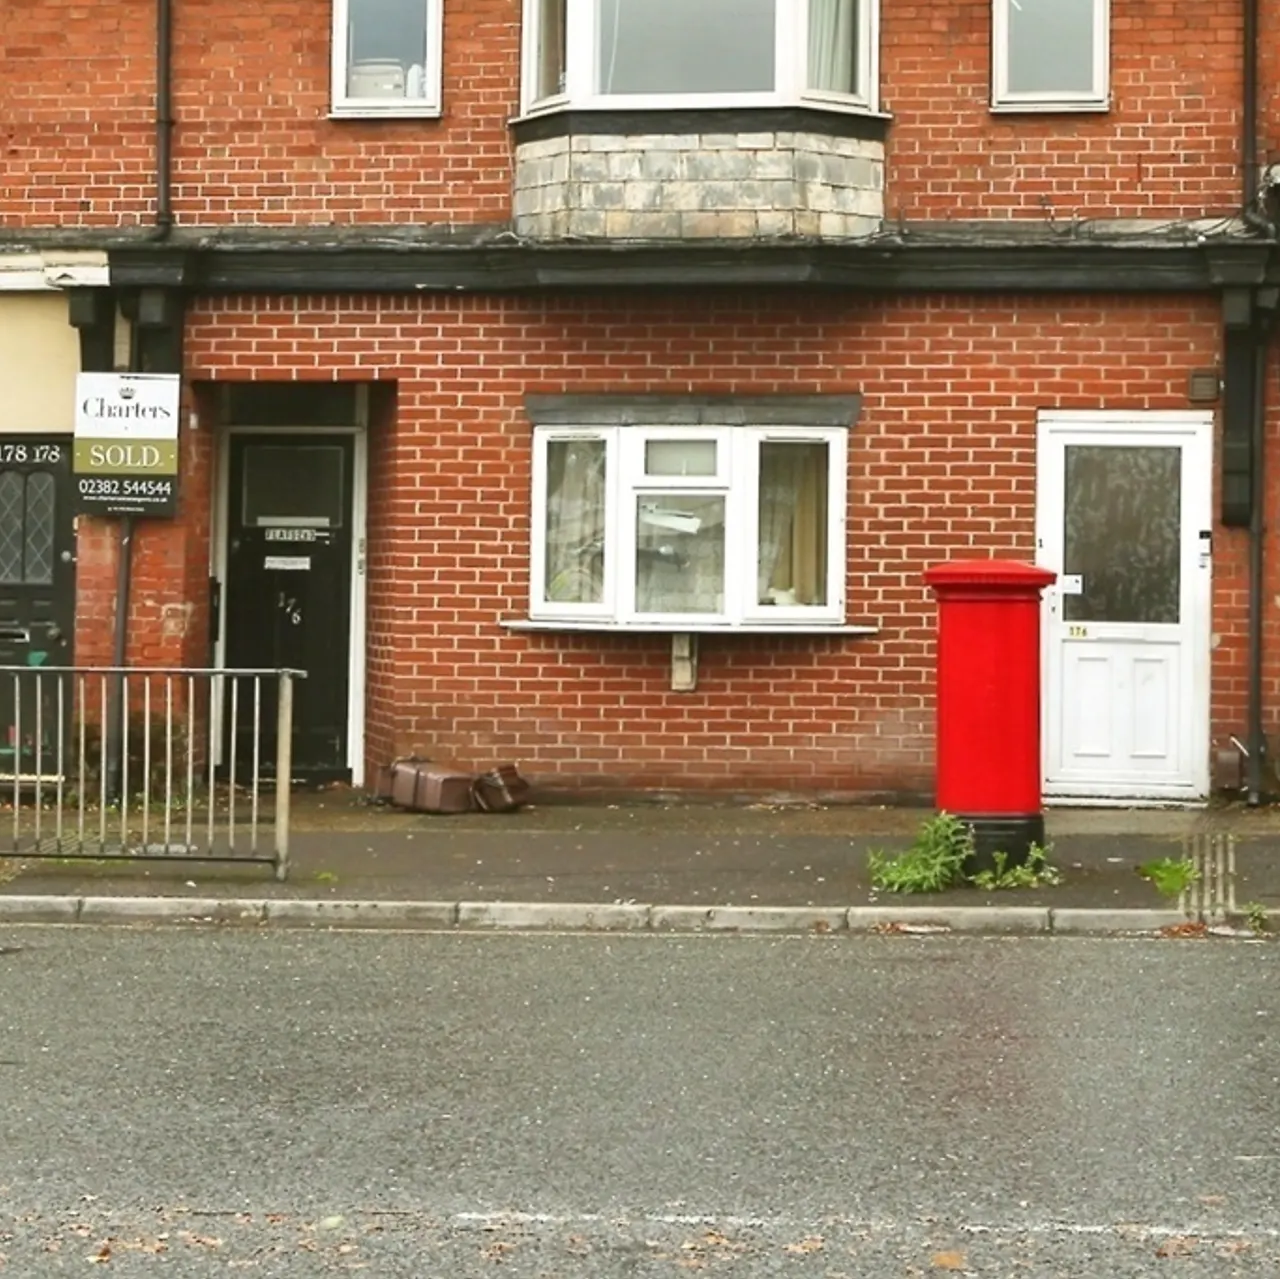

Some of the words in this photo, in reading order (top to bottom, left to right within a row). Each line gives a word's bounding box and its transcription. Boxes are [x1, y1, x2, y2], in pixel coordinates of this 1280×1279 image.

[82, 397, 171, 419] Charters
[90, 444, 160, 467] SOLD
[79, 478, 120, 494] 02382
[123, 480, 171, 496] 544544
